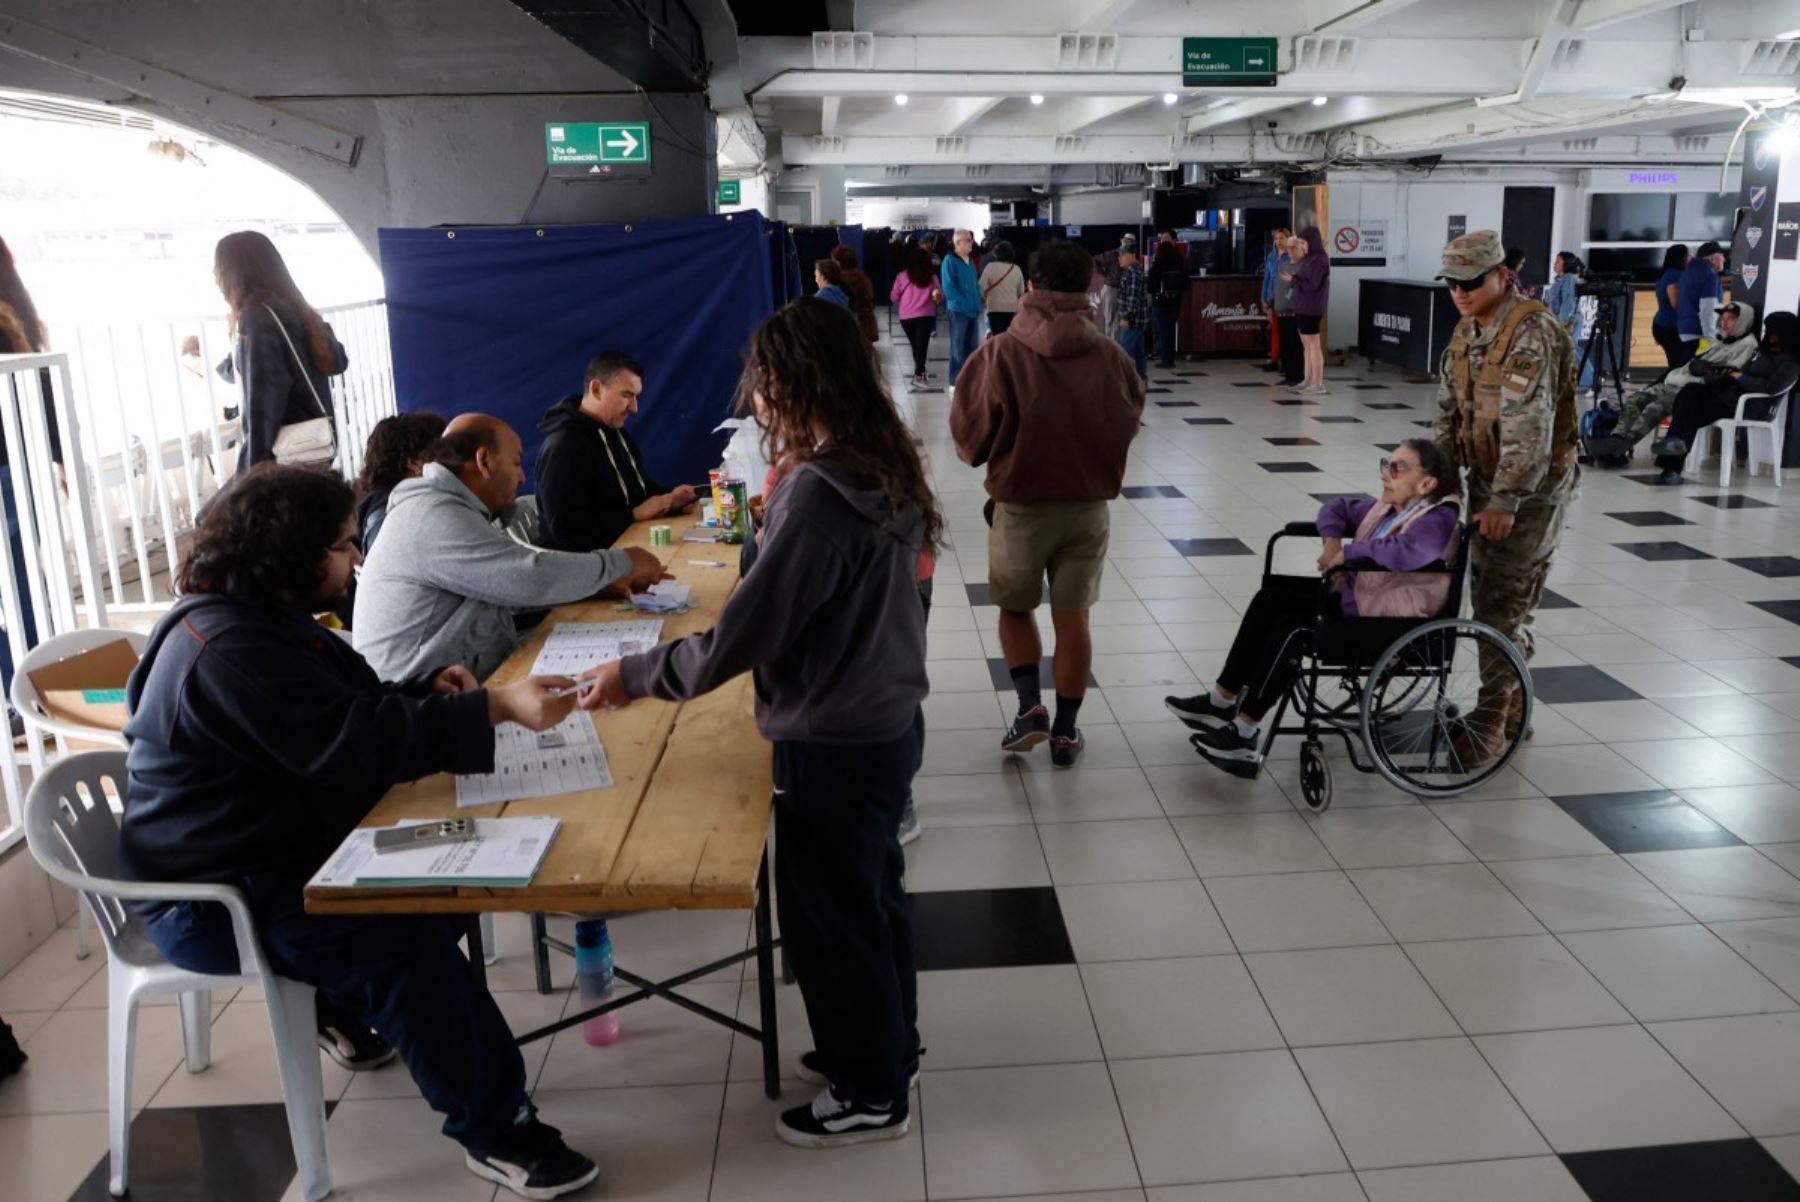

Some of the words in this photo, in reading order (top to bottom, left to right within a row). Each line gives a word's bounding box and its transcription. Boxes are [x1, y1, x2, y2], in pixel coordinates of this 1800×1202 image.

[1201, 51, 1211, 59] de
[1187, 62, 1230, 70] Evacuación
[566, 146, 577, 154] de
[1630, 173, 1677, 184] PHILIPS
[1511, 358, 1532, 371] MP
